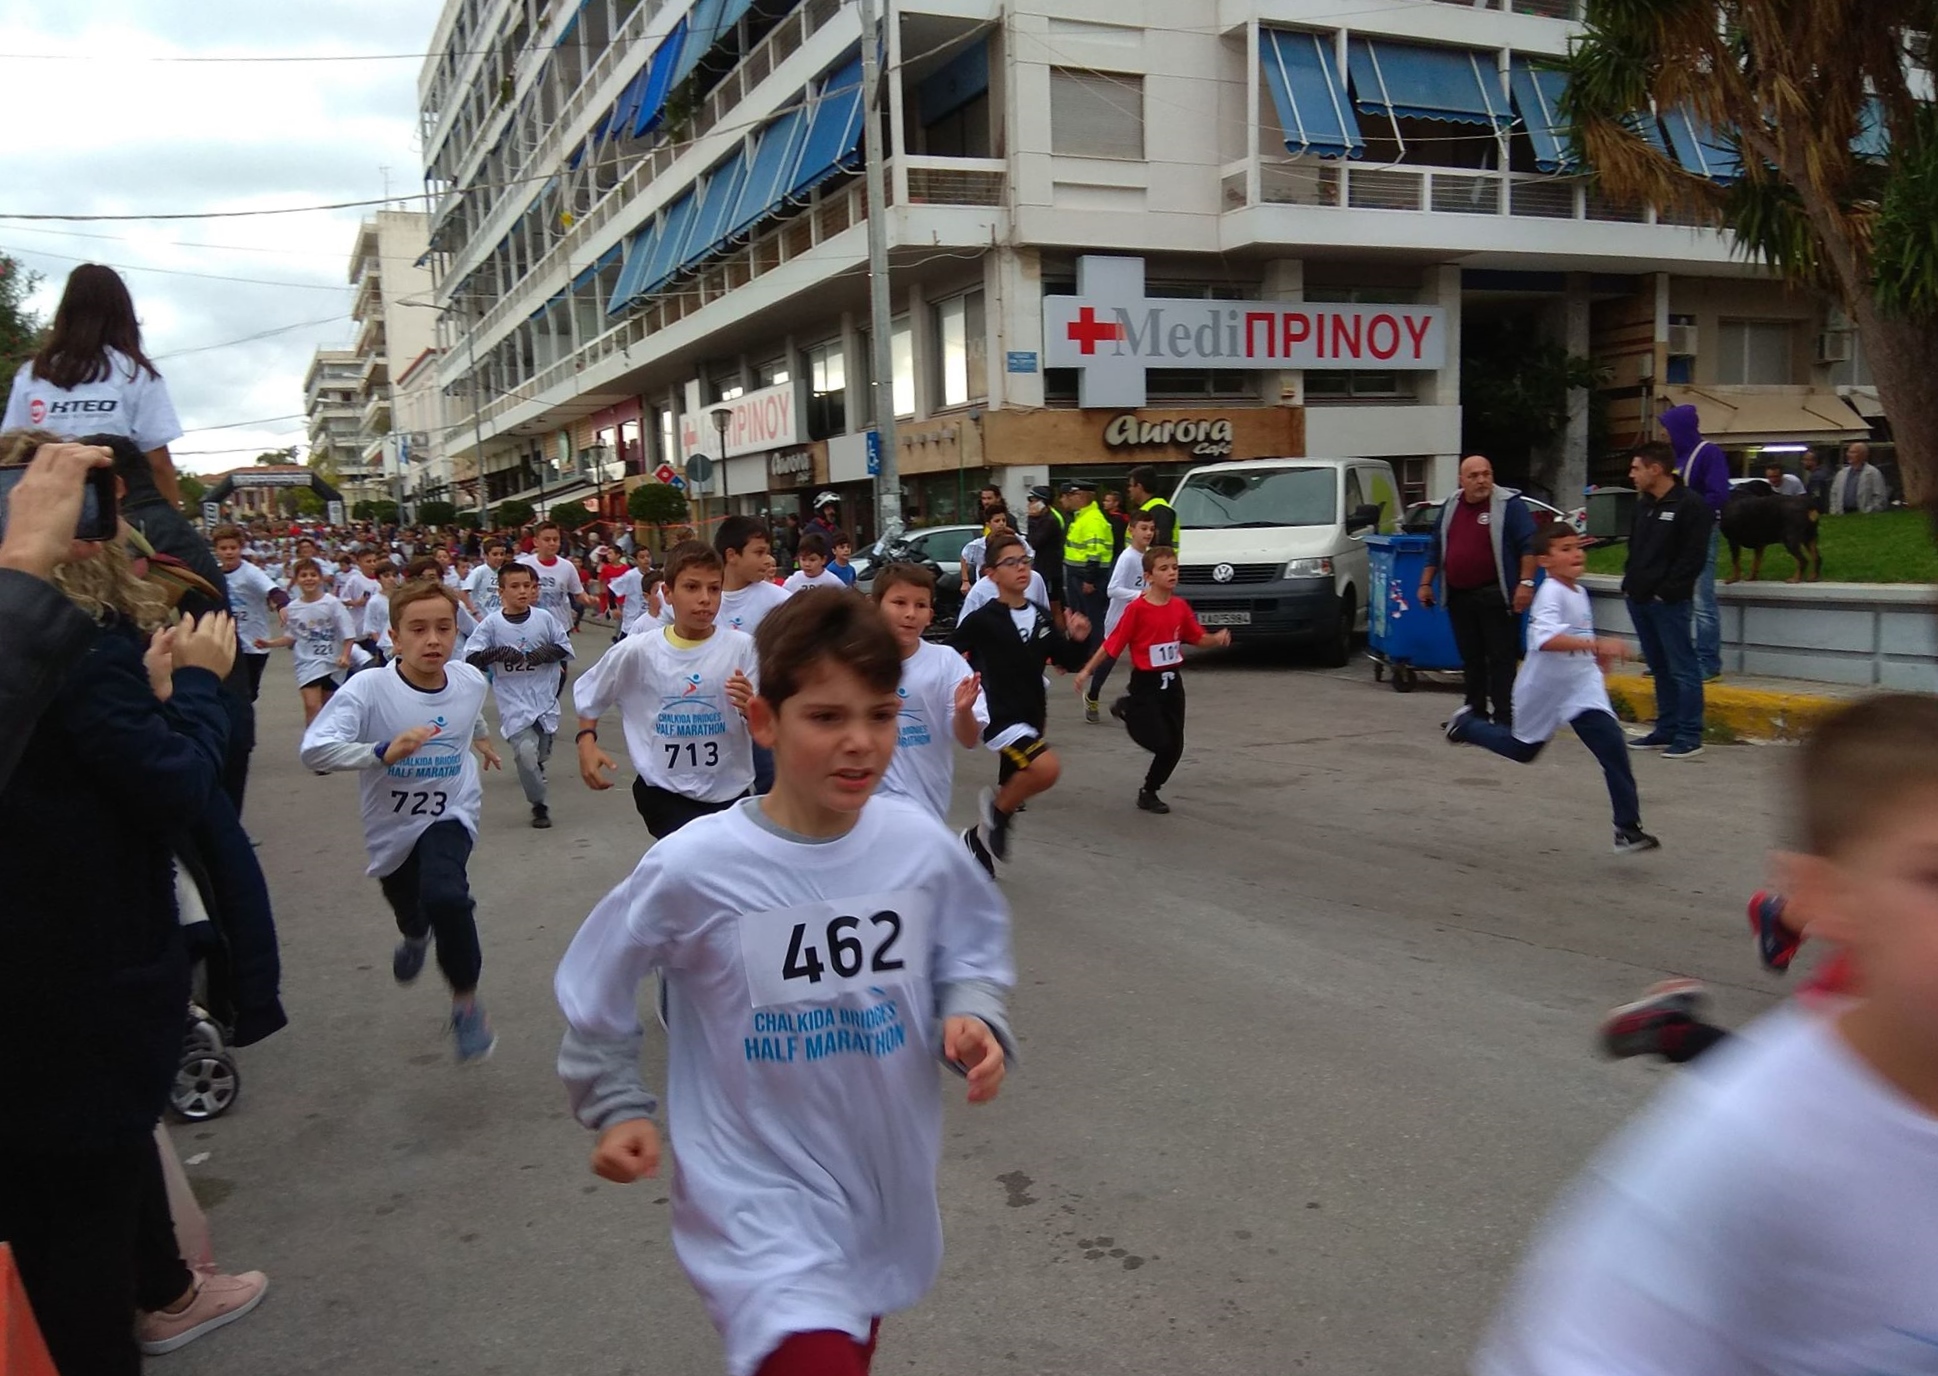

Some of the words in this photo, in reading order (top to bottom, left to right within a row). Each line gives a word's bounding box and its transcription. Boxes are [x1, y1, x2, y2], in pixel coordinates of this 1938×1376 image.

[677, 722, 726, 736] MARATHON
[665, 742, 719, 769] 713
[388, 765, 413, 778] HALF
[391, 790, 447, 816] 723
[782, 910, 904, 984] 462
[755, 1008, 835, 1033] CHALKIDA
[744, 1036, 798, 1064] HALF
[806, 1023, 905, 1062] MARATHON
